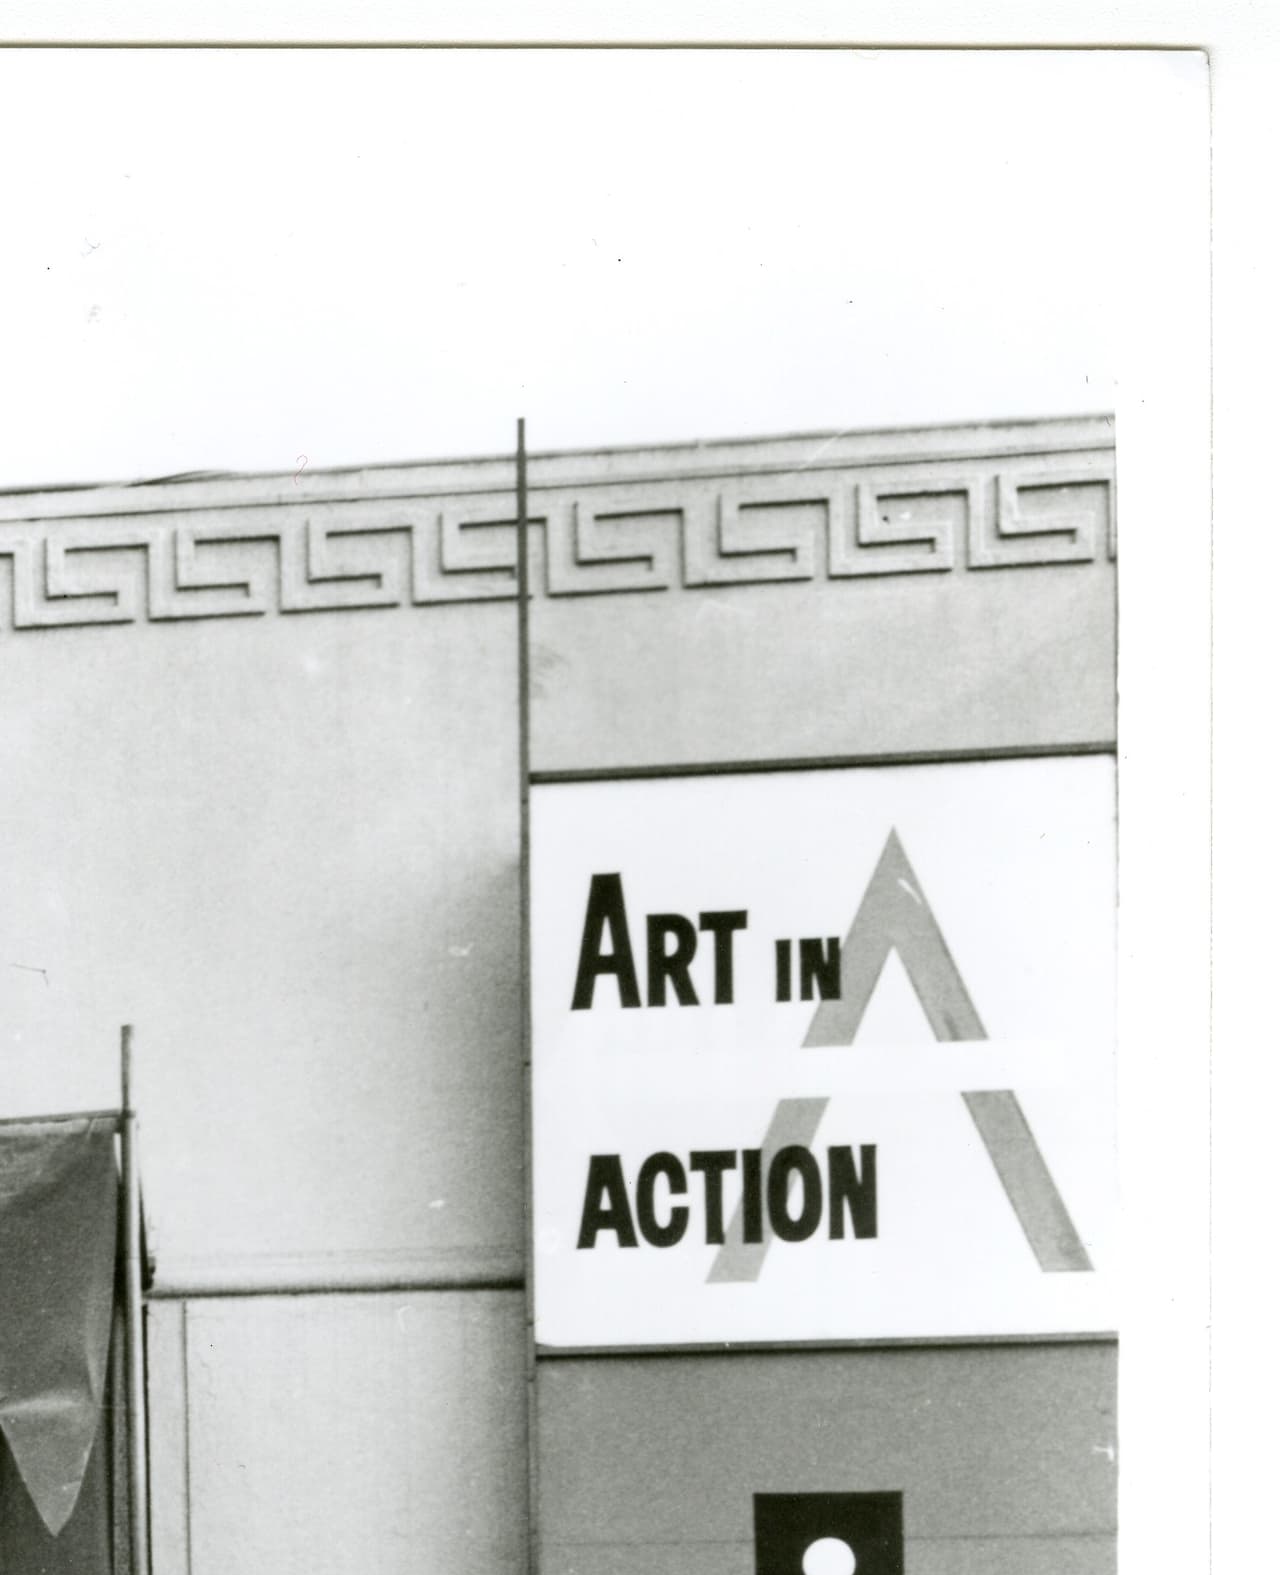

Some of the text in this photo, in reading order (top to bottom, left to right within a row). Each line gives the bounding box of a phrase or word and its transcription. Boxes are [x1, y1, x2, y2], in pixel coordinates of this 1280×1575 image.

[571, 872, 841, 1011] ART IN
[577, 1144, 878, 1249] ACTION
